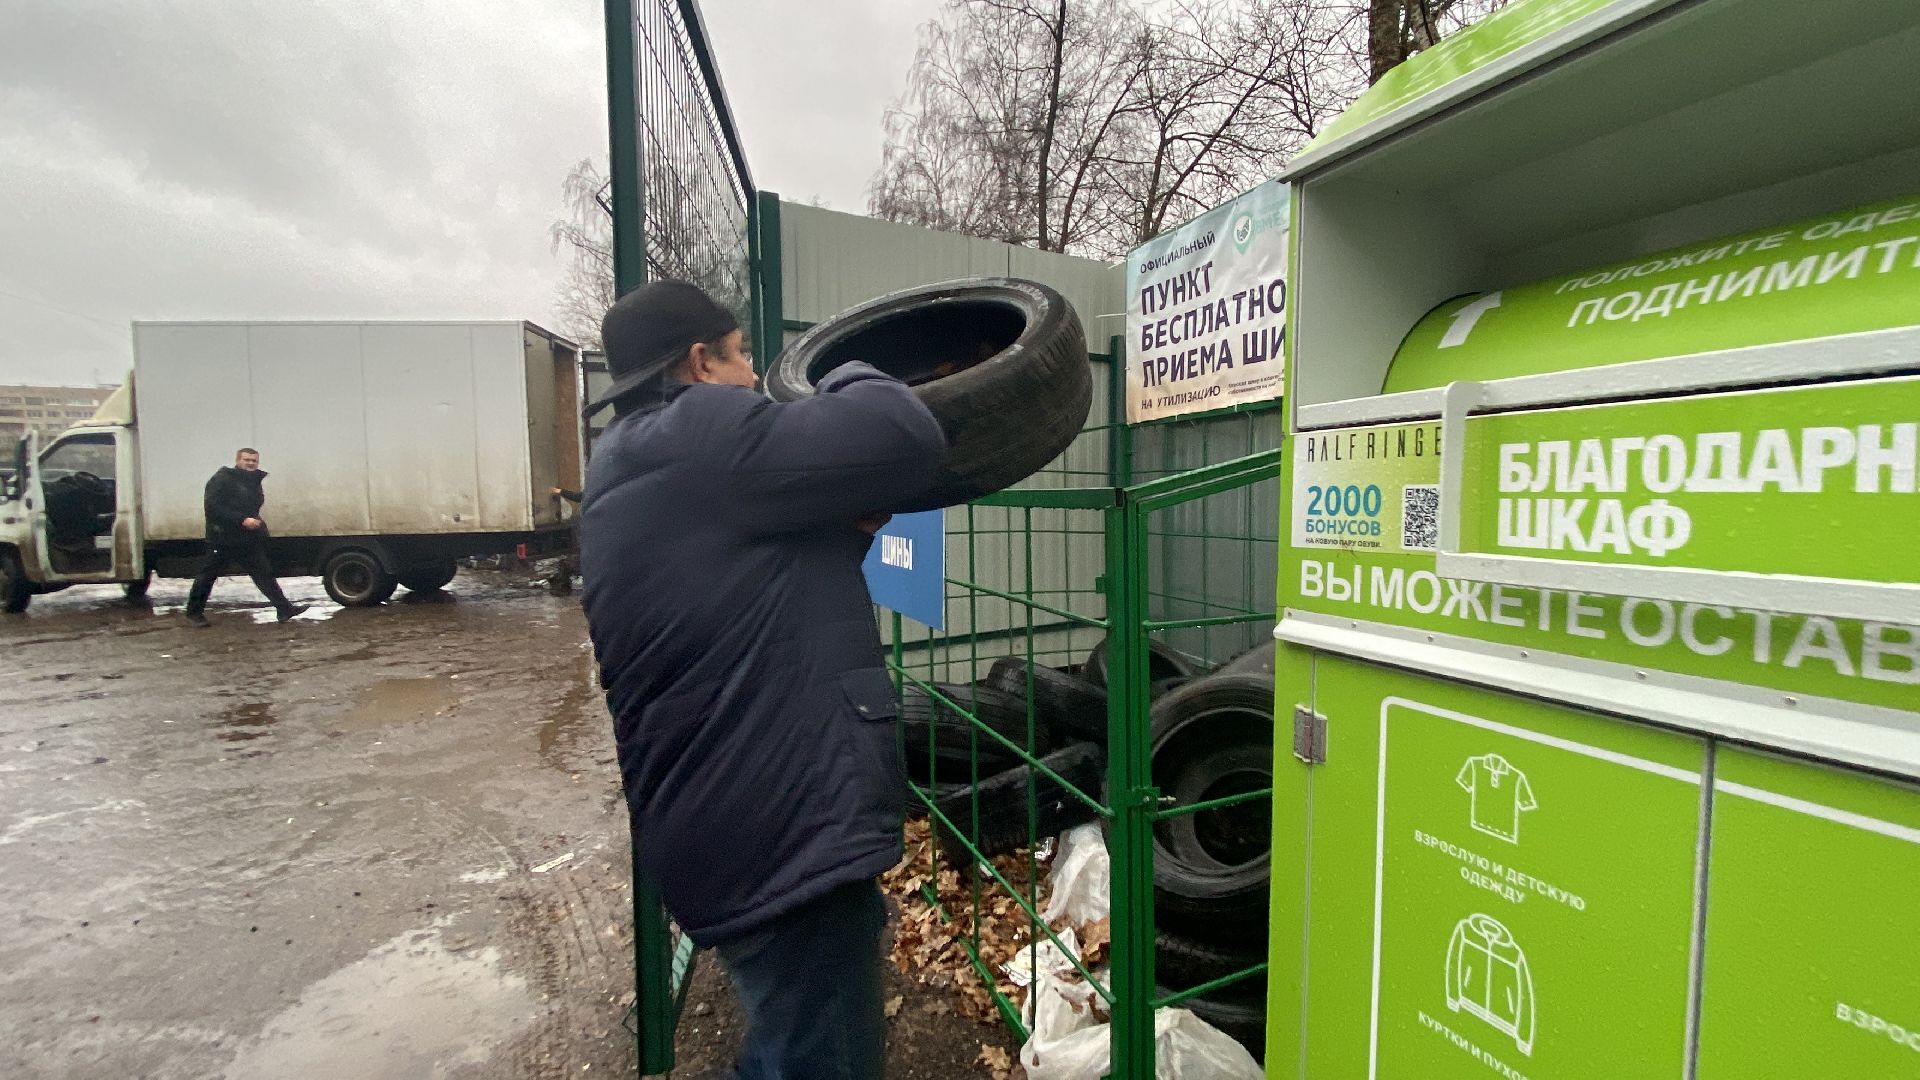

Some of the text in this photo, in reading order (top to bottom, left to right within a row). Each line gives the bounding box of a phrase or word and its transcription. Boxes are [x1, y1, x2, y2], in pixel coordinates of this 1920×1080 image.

[1140, 231, 1216, 273] ОФИЦИАЛЬНЫЙ
[1555, 203, 1920, 295] ПОЛОЖИТЕ ОДЕ
[1141, 261, 1213, 315] ПУНКТ
[1568, 235, 1920, 328] ПОДНИМИТ
[1141, 278, 1285, 352] БЕСПЛАТНО
[1142, 339, 1234, 388] ПРИЕМА
[1141, 399, 1153, 410] НА
[1157, 385, 1221, 408] УТИЛИЗАЦИЮ
[1307, 484, 1382, 517] 2000
[1305, 518, 1381, 536] БОНУСОВ
[1498, 497, 1692, 557] ШКАФ
[881, 534, 913, 571] ШИНЫ
[1300, 559, 1920, 685] ВЫ МОЖЕТЕ ОСТАВ
[1414, 829, 1586, 911] ВЗРОСЛУЮ И ДЕТСКУЮ
[1460, 866, 1525, 904] ОДЕЖДУ
[1418, 1010, 1469, 1052] КУРТКИ
[1471, 1043, 1481, 1060] И
